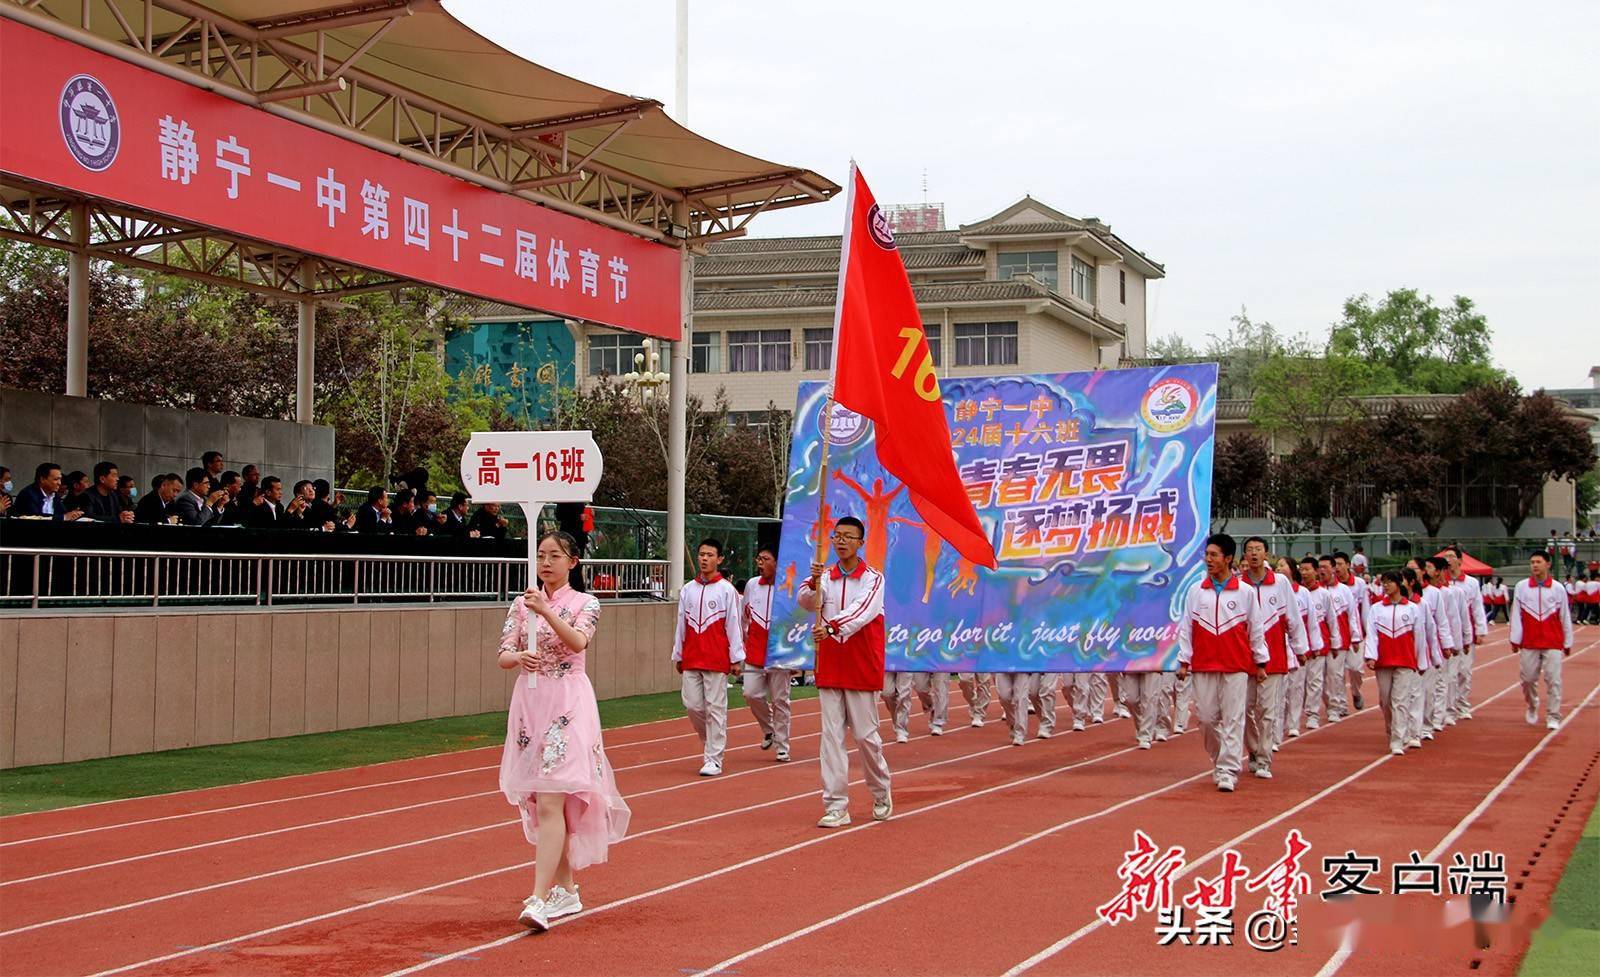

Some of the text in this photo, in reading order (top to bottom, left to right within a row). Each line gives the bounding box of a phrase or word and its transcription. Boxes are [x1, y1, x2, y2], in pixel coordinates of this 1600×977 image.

[158, 114, 630, 304] 静宁一中第四十二届体育节
[890, 326, 942, 402] 16
[951, 420, 1080, 448] 24届十六班
[954, 394, 1054, 423] 静宁一中
[476, 446, 586, 486] 高一16班
[960, 440, 1130, 509] 青春无畏
[997, 488, 1179, 562] 逐梦扬威
[887, 623, 909, 643] to
[916, 626, 943, 651] go
[949, 619, 983, 650] for
[1028, 621, 1080, 650] just
[1083, 618, 1120, 652] fly
